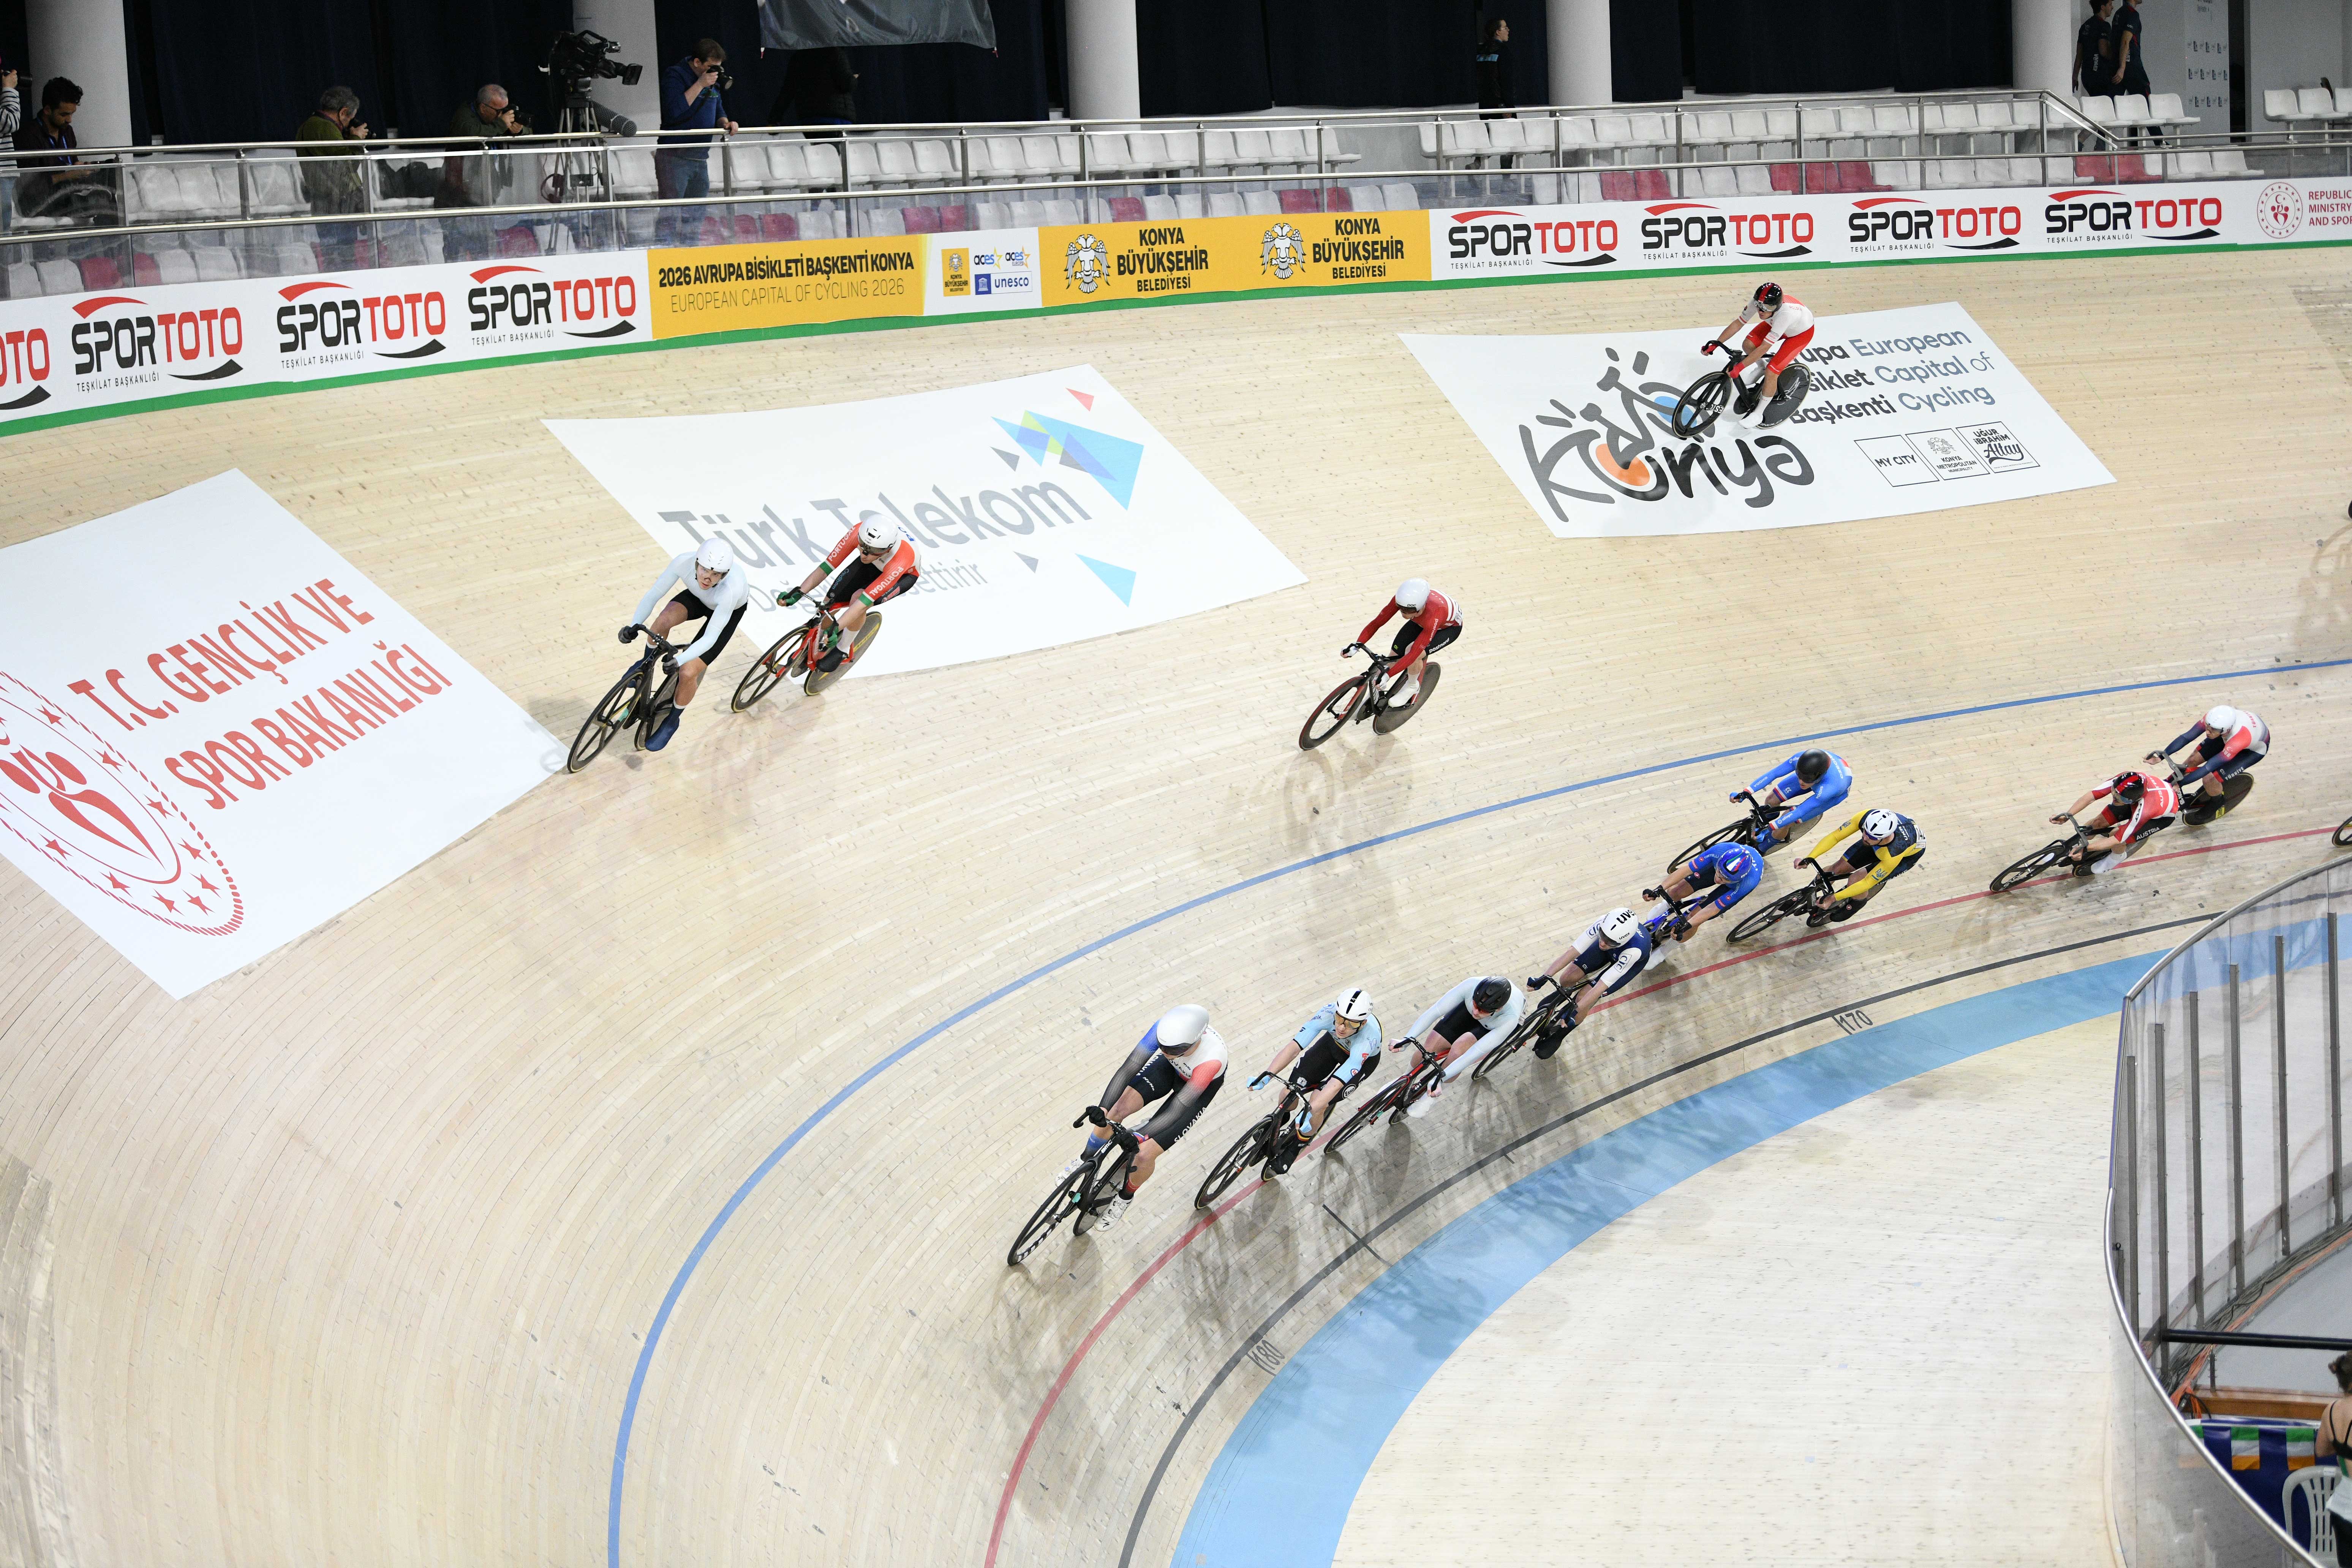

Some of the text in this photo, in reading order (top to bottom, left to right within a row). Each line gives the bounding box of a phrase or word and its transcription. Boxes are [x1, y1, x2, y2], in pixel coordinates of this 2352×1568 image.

[2309, 190, 2352, 200] REPUBLIC
[2309, 203, 2352, 213] MINISTRY
[1335, 218, 1381, 236] KONYA
[2309, 217, 2329, 226] AND
[1139, 227, 1185, 246] KONYA
[2086, 233, 2132, 242] BAŞKANLIĞI
[1005, 251, 1023, 261] aces
[1312, 236, 1404, 264] BÜYÜKŞEHİR
[1644, 250, 1727, 261] TEŞKİLAT BAŞKANLIĞI
[1851, 242, 1934, 253] TEŞKİLAT BAŞKANLIĞI
[659, 249, 914, 288] 2026 AVRUPA BİSİKLETİ BAŞKENTİ KONYA
[974, 254, 994, 265] aces
[1117, 245, 1209, 276] BÜYÜKŞEHİR
[1451, 258, 1533, 270] TEŞKİLAT BAŞKANLIĞI
[1332, 262, 1386, 279] BELEDİYESİ
[994, 277, 1029, 288] unesco
[1137, 273, 1191, 292] BELEDİYESİ
[671, 278, 904, 313] EUROPEAN CAPITAL OF CYCLING 2026
[472, 329, 554, 346] TEŞKİLAT BAŞKANLIĞI
[1849, 330, 1972, 360] European
[281, 350, 364, 370] TEŞKİLAT BAŞKANLIĞI
[1874, 355, 1969, 384] Capital
[1970, 351, 1995, 372] of
[77, 371, 160, 394] TEŞKİLAT BAŞKANLIĞI
[1898, 385, 1995, 413] Cycling
[1973, 429, 2000, 437] UĞUR
[1874, 454, 1918, 468] MY CITY
[1984, 443, 2024, 465] Altay
[1936, 460, 1977, 469] METROPOLITAN
[657, 504, 831, 569] Türk
[828, 526, 855, 561] PORTUGAL
[869, 566, 904, 596] PORTUGAL
[291, 579, 375, 633] VE
[1429, 637, 1449, 653] postnord
[164, 640, 452, 809] SPOR BAKANLIĞI
[2136, 827, 2160, 840] AUSTRIA
[1839, 1010, 1873, 1031] 170
[1174, 1107, 1207, 1143] SLOVAKIA
[1101, 1141, 1113, 1153] BMC
[1252, 1340, 1285, 1370] 180
